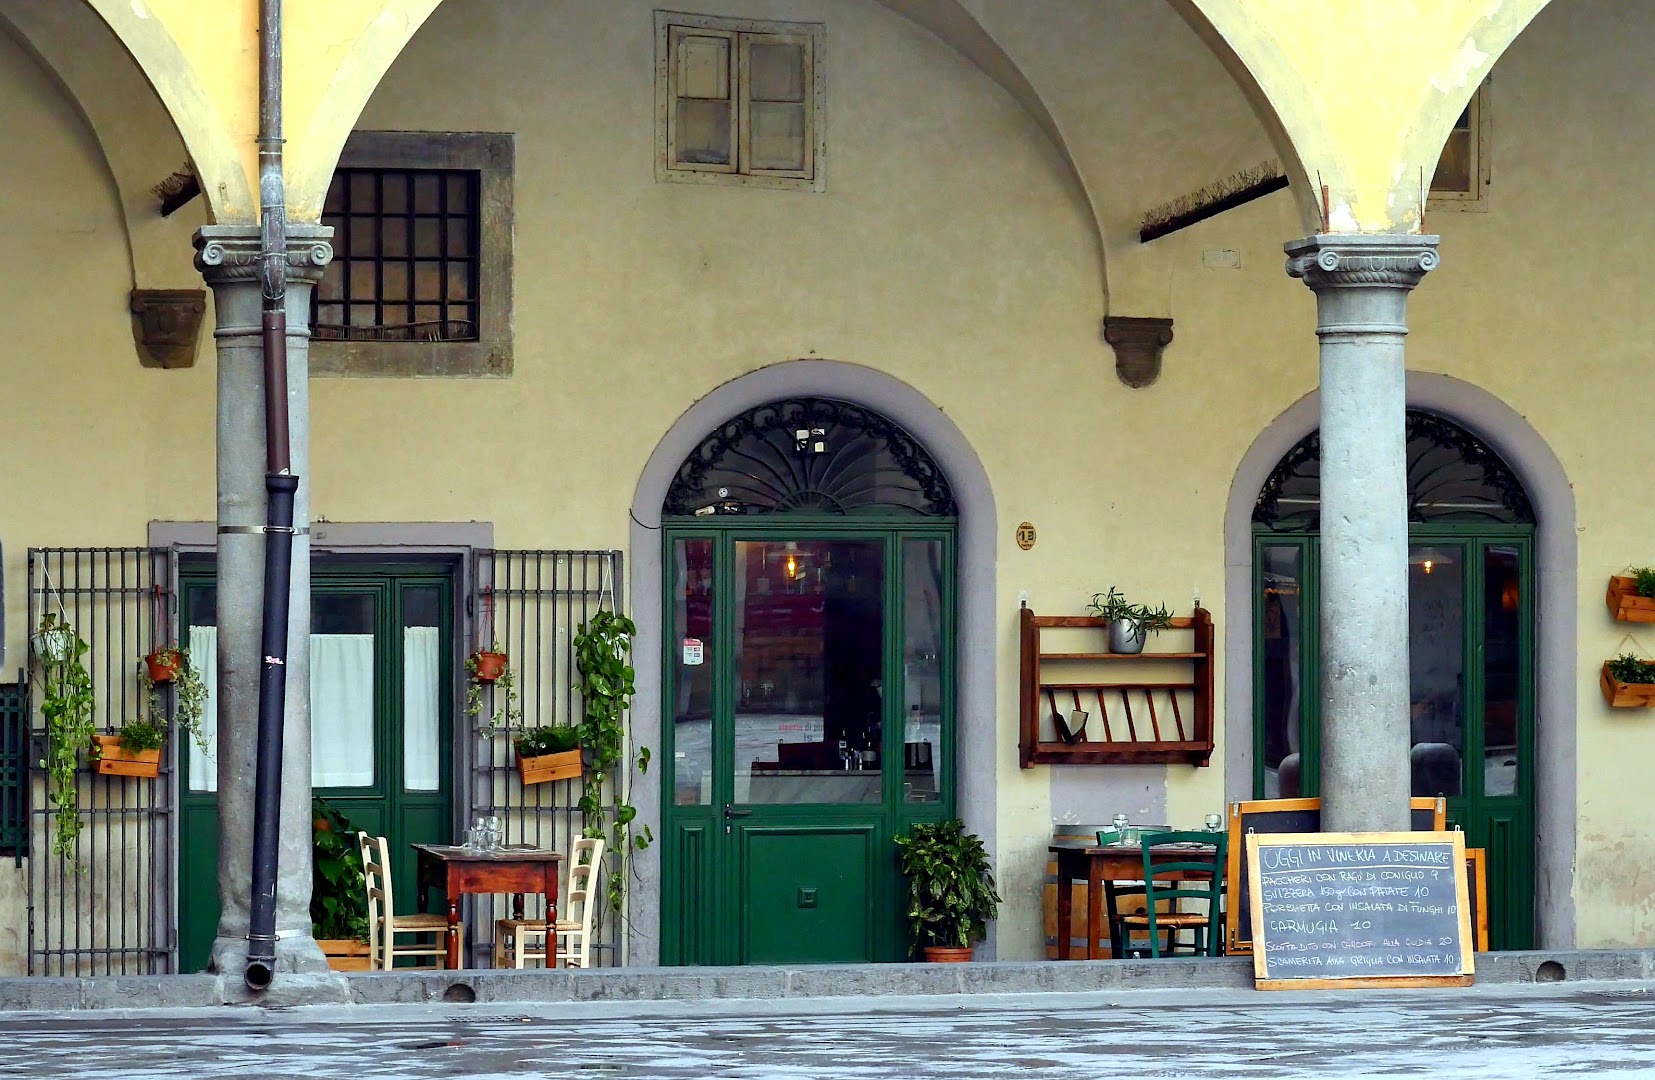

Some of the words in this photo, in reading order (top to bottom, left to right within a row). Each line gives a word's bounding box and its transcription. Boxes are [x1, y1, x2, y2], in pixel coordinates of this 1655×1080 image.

[1308, 848, 1321, 863] IN
[1382, 849, 1391, 862] A
[1393, 849, 1451, 865] DESINARE
[1262, 874, 1312, 886] PACCHERI
[1315, 872, 1335, 883] CON
[1366, 871, 1376, 881] DI
[1264, 888, 1315, 901] SVIZZERA
[1347, 885, 1367, 897] CON
[1370, 886, 1410, 897] PATATE
[1414, 885, 1430, 898] 10
[1325, 902, 1344, 912] CON
[1348, 901, 1393, 912] INSALATA
[1398, 903, 1408, 912] DI
[1408, 901, 1443, 916] FUNGHI
[1447, 905, 1456, 915] 10
[1270, 919, 1339, 936] GARMUGIA
[1350, 920, 1371, 930] 10
[1321, 940, 1337, 949] CON
[1383, 938, 1401, 947] ALLA
[1438, 936, 1453, 946] 20
[1267, 956, 1323, 968] SCAMERITA
[1386, 954, 1404, 965] CON
[1443, 953, 1454, 965] 10
